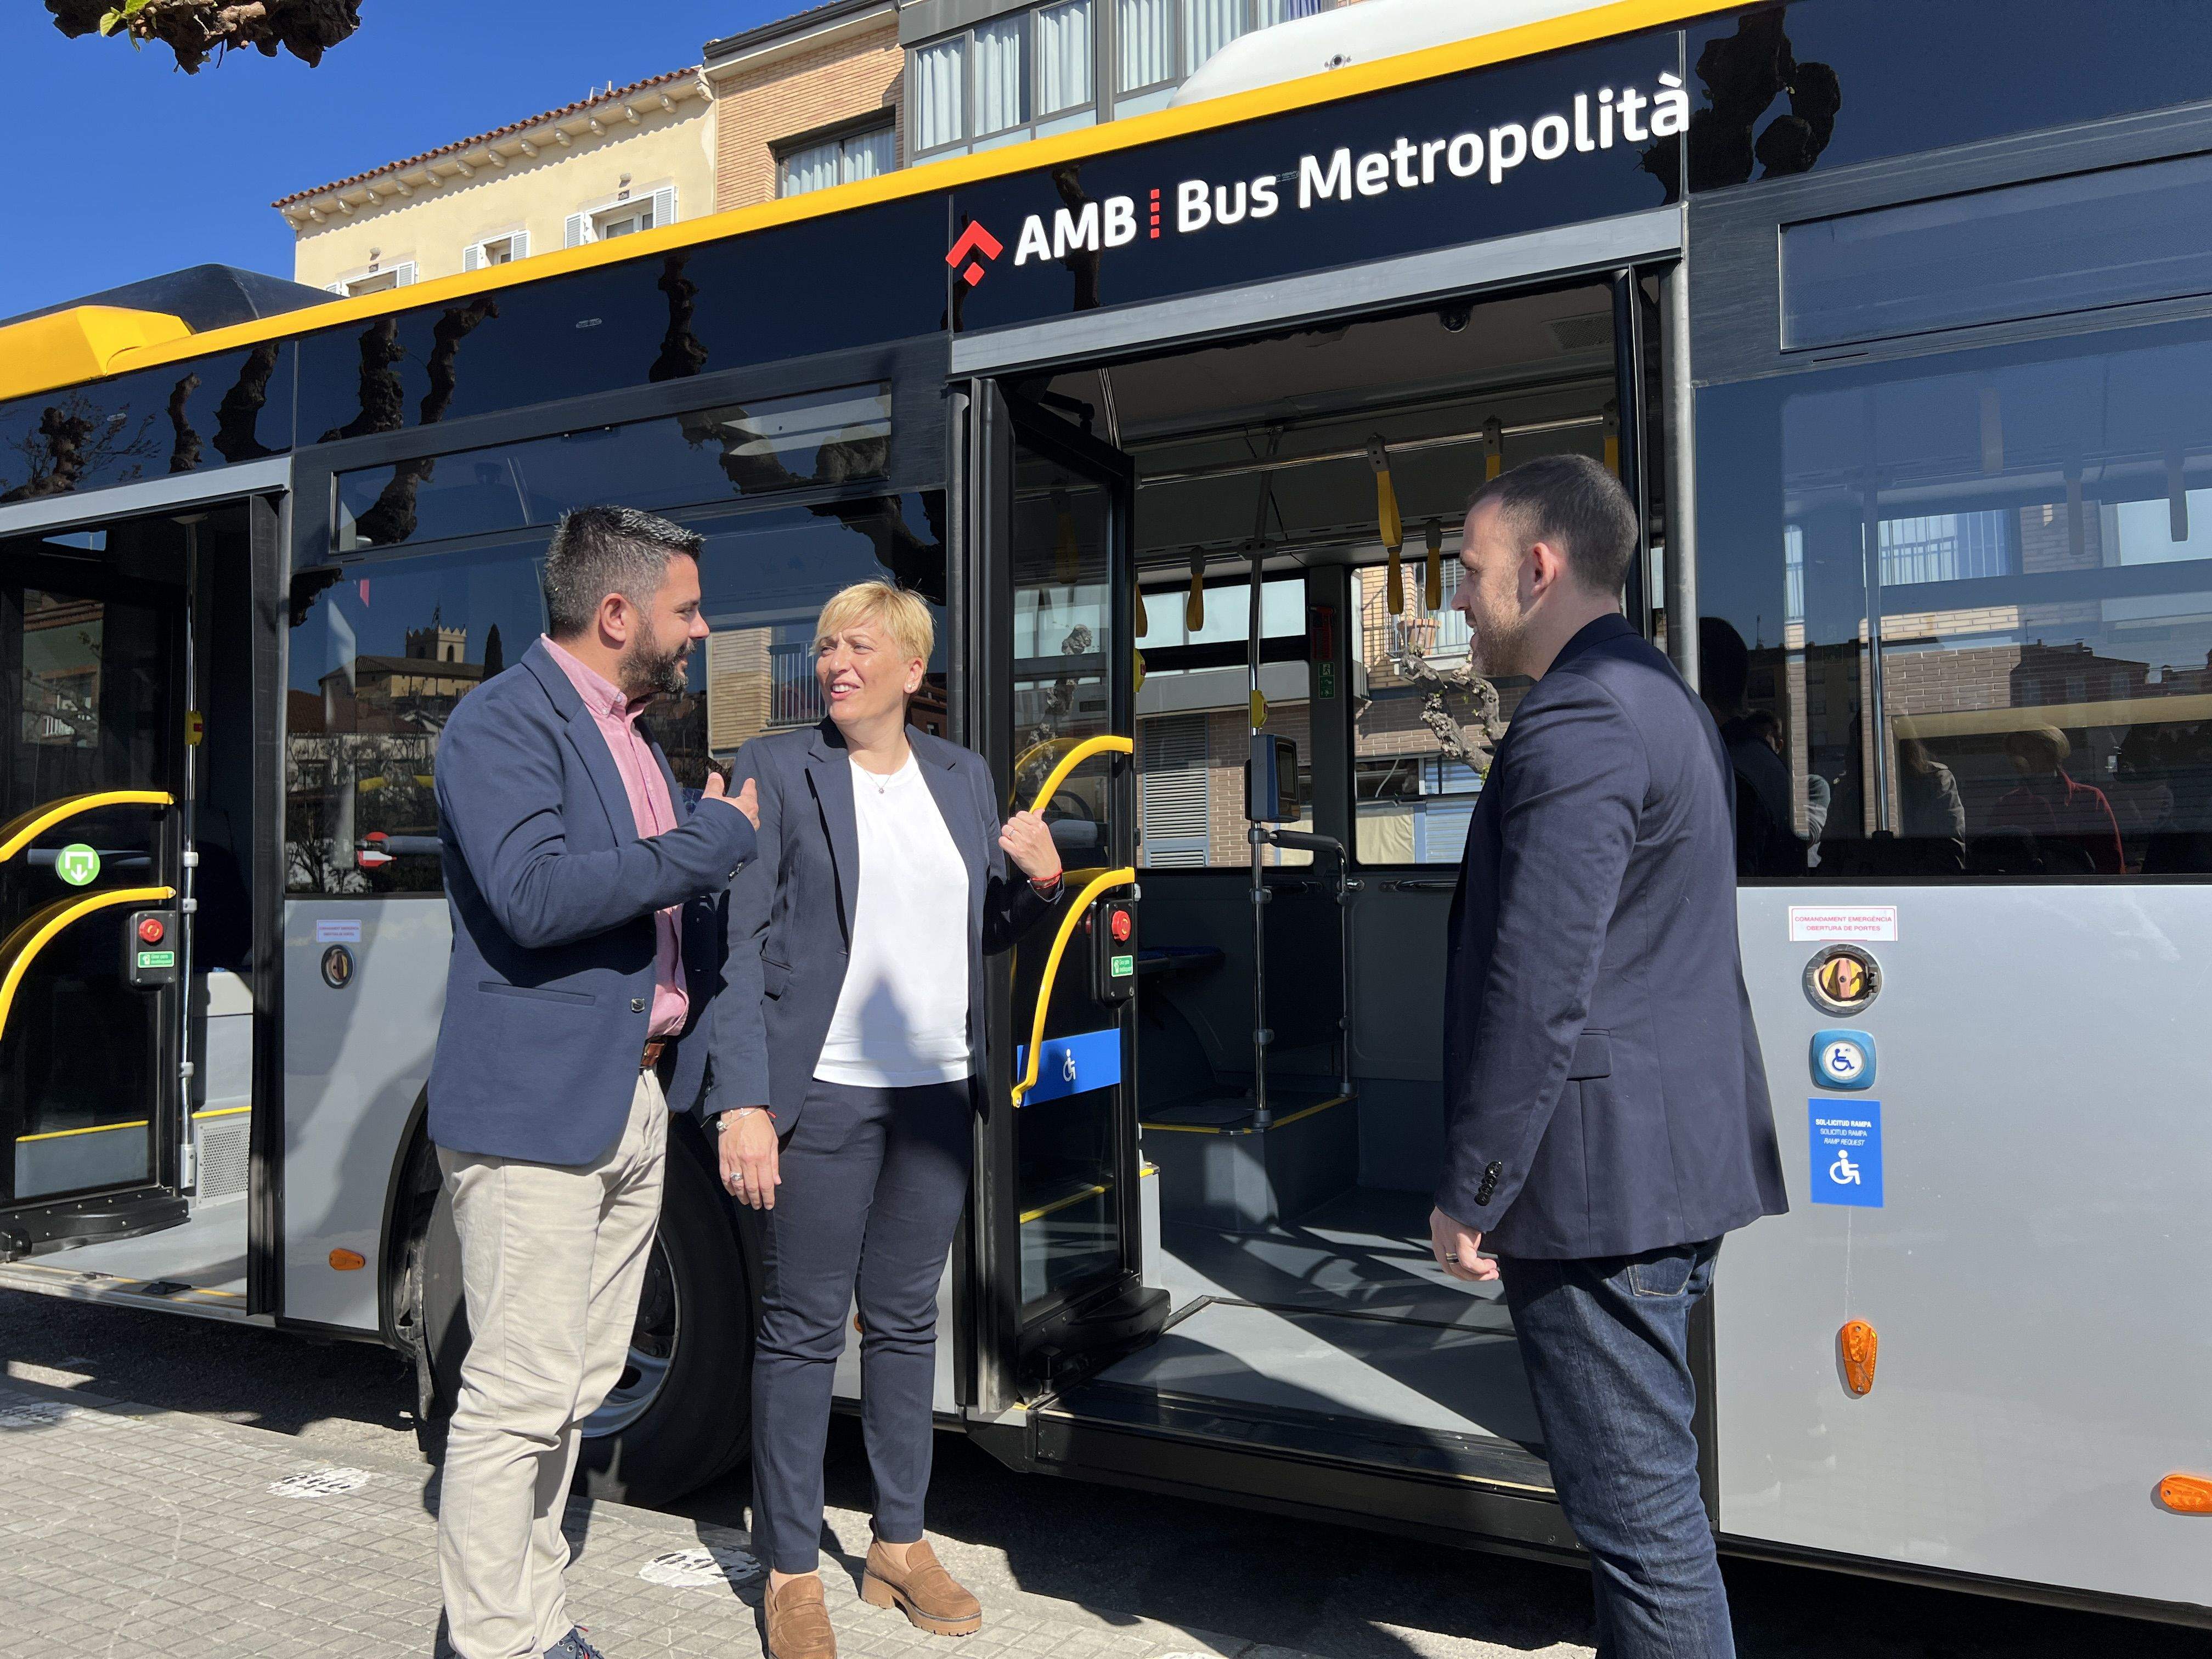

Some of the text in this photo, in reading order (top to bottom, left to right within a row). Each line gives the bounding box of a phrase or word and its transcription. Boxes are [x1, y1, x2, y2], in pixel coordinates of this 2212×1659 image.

[1014, 72, 1690, 266] AMB Bus Metropolità
[1820, 1128, 1847, 1136] SOLICITUD
